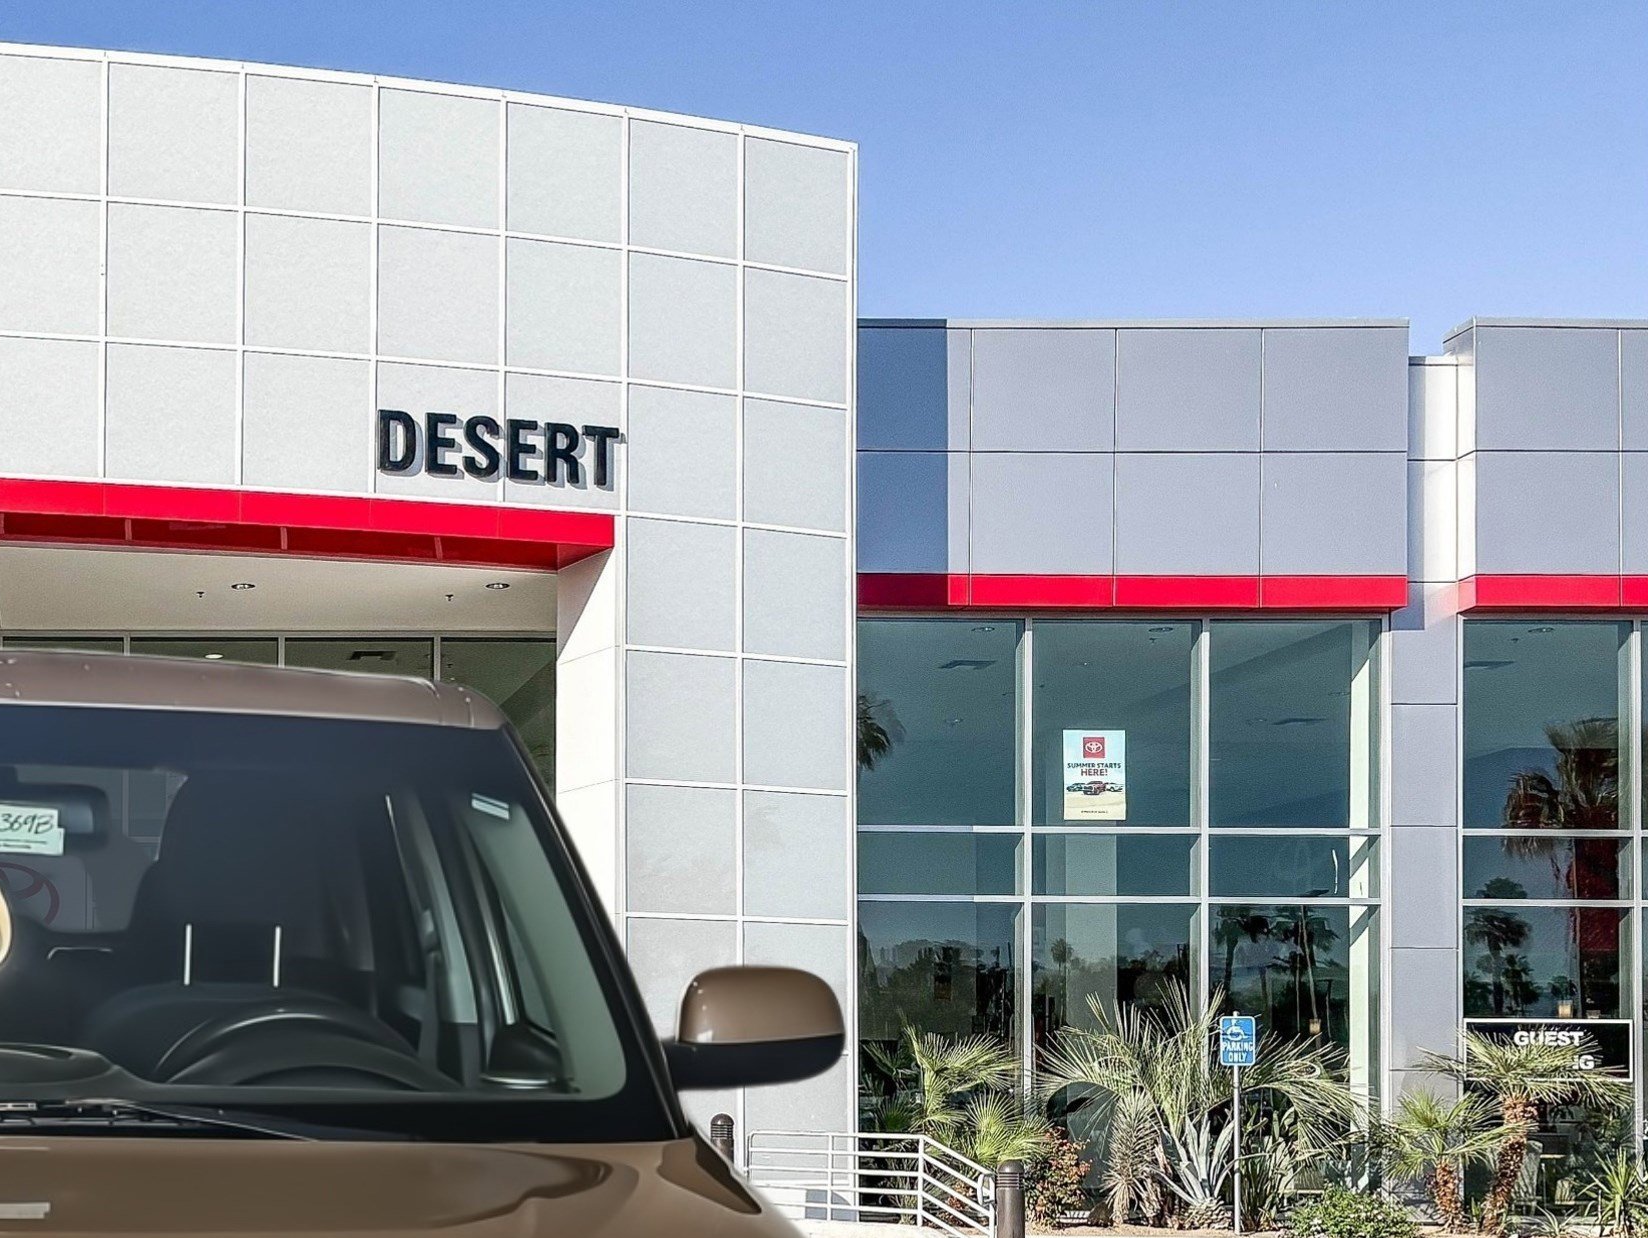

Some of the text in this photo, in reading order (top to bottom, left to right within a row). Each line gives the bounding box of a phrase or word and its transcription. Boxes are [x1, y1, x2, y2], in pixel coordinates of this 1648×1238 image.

[377, 409, 621, 487] DESERT
[1514, 1031, 1584, 1046] GUEST
[1222, 1041, 1253, 1051] PARKING
[1228, 1052, 1247, 1062] ONLY
